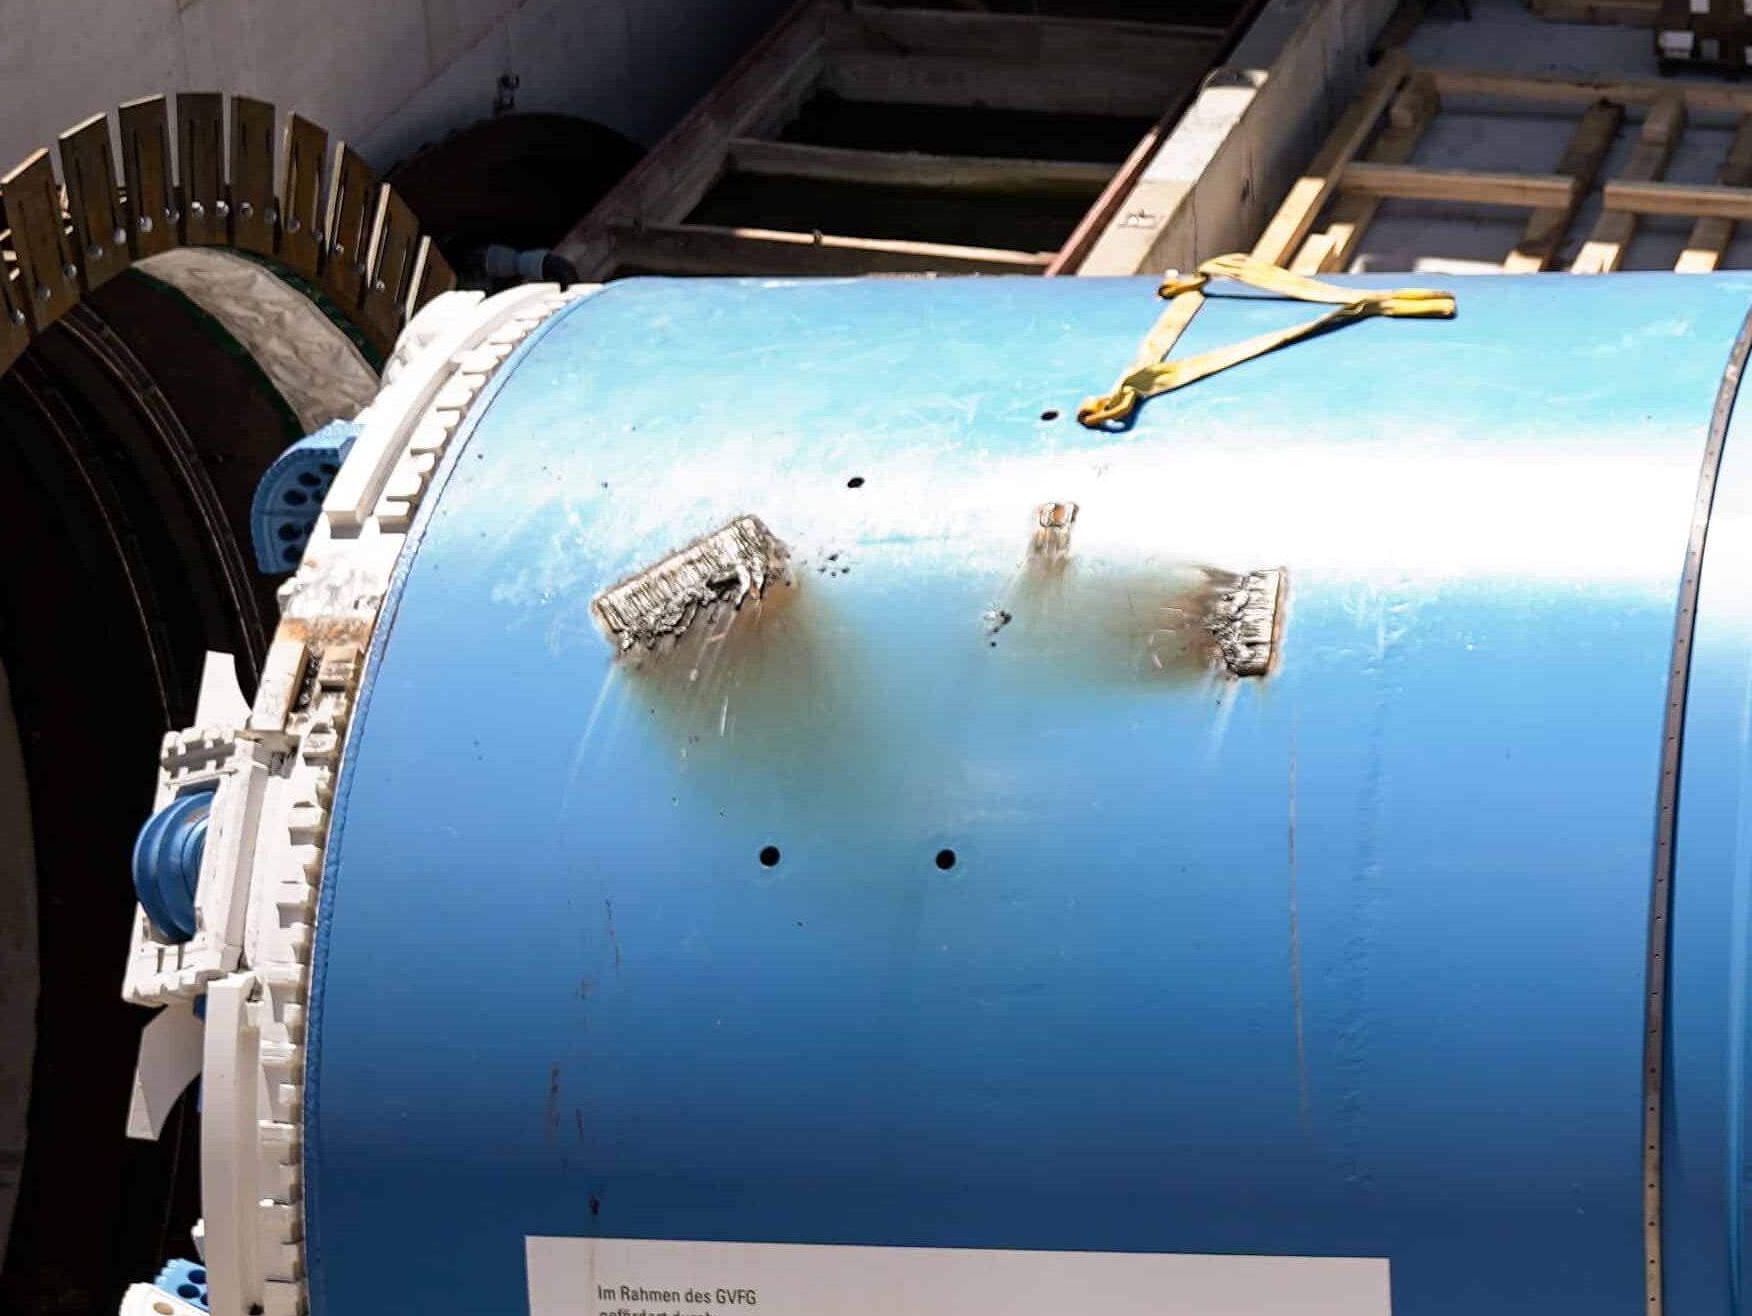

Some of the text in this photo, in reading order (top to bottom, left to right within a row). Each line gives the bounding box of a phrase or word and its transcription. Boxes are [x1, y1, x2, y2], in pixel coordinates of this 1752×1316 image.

[598, 1285, 757, 1305] Im Rahmen des GVFG
